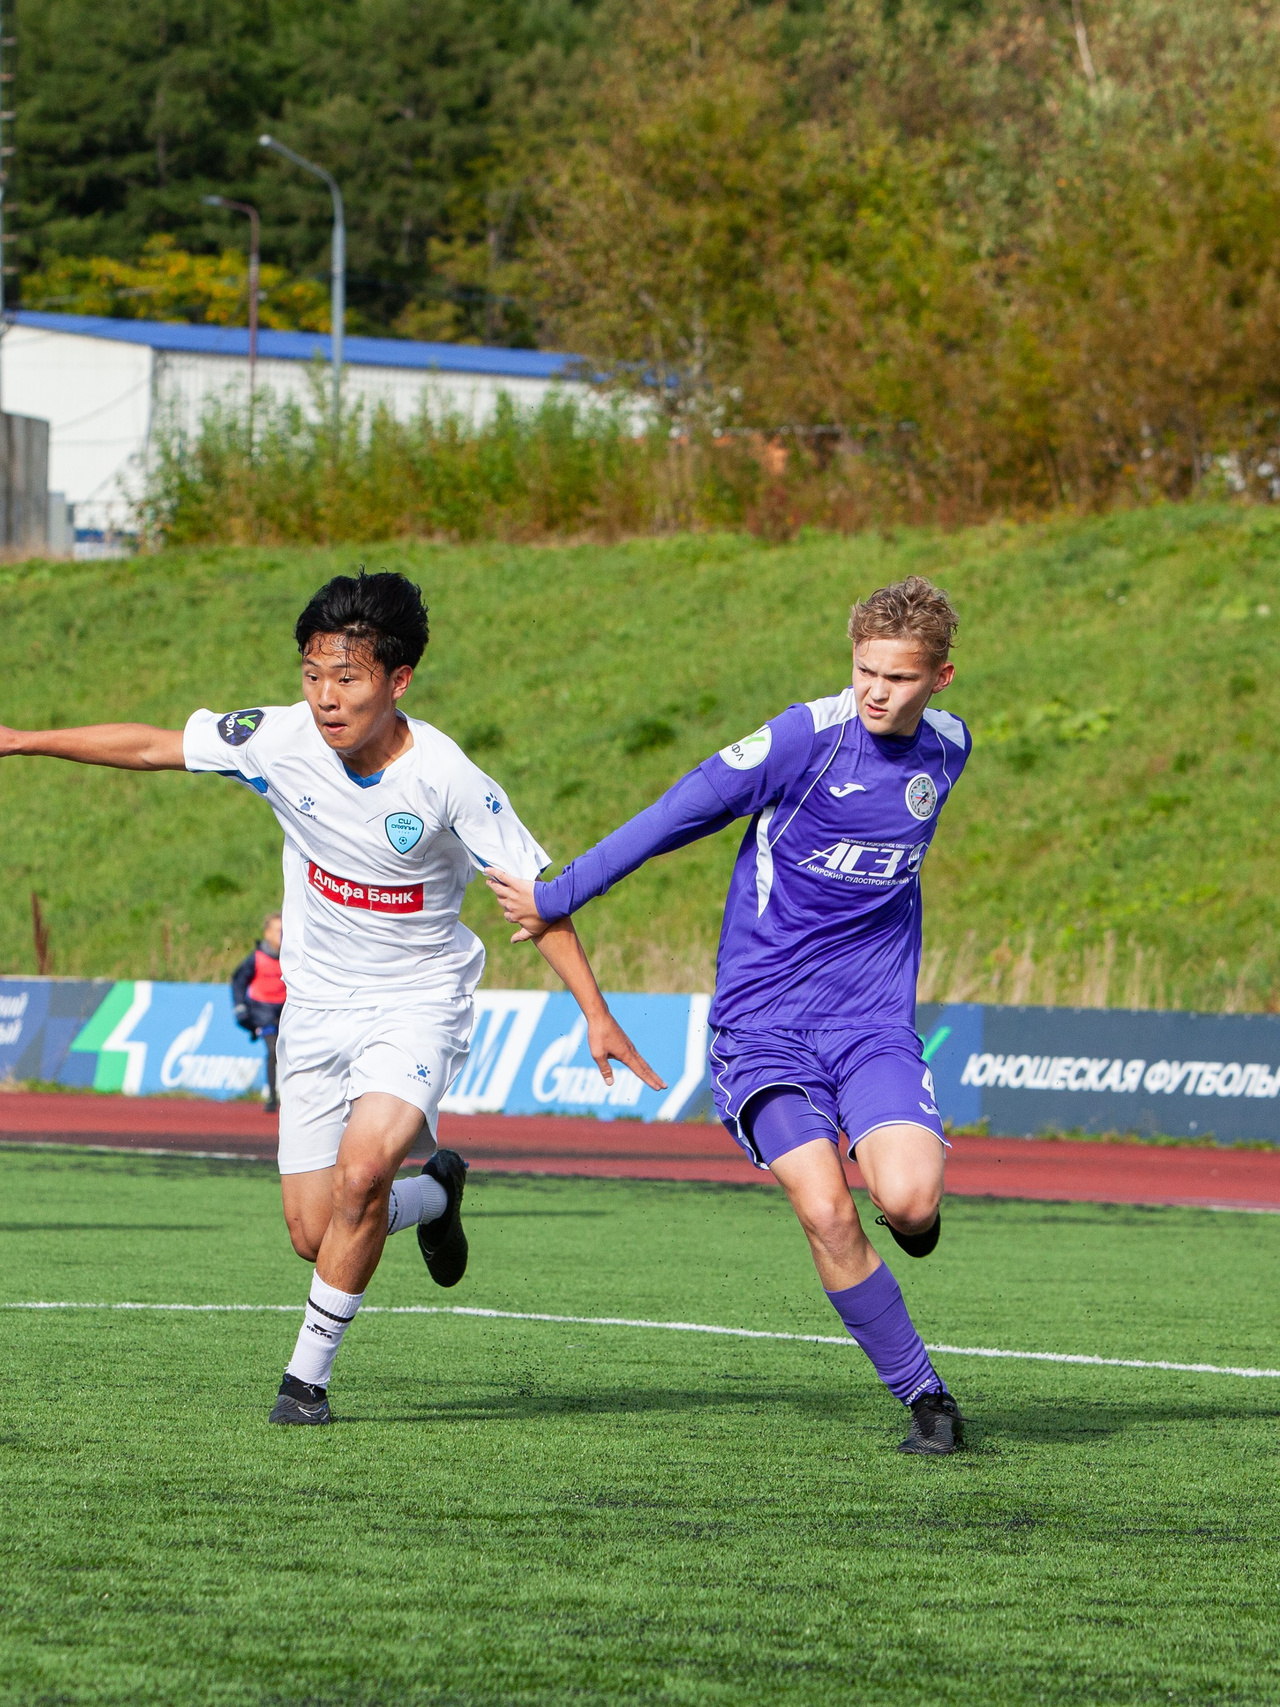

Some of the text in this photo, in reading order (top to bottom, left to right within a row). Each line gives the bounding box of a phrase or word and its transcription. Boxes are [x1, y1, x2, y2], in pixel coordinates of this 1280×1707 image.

[731, 743, 744, 761] ФЛ
[807, 864, 843, 880] АМУРСКИЙ
[313, 868, 414, 904] Альфа Банк
[960, 1053, 1146, 1093] ЮНОШЕСКАЯ
